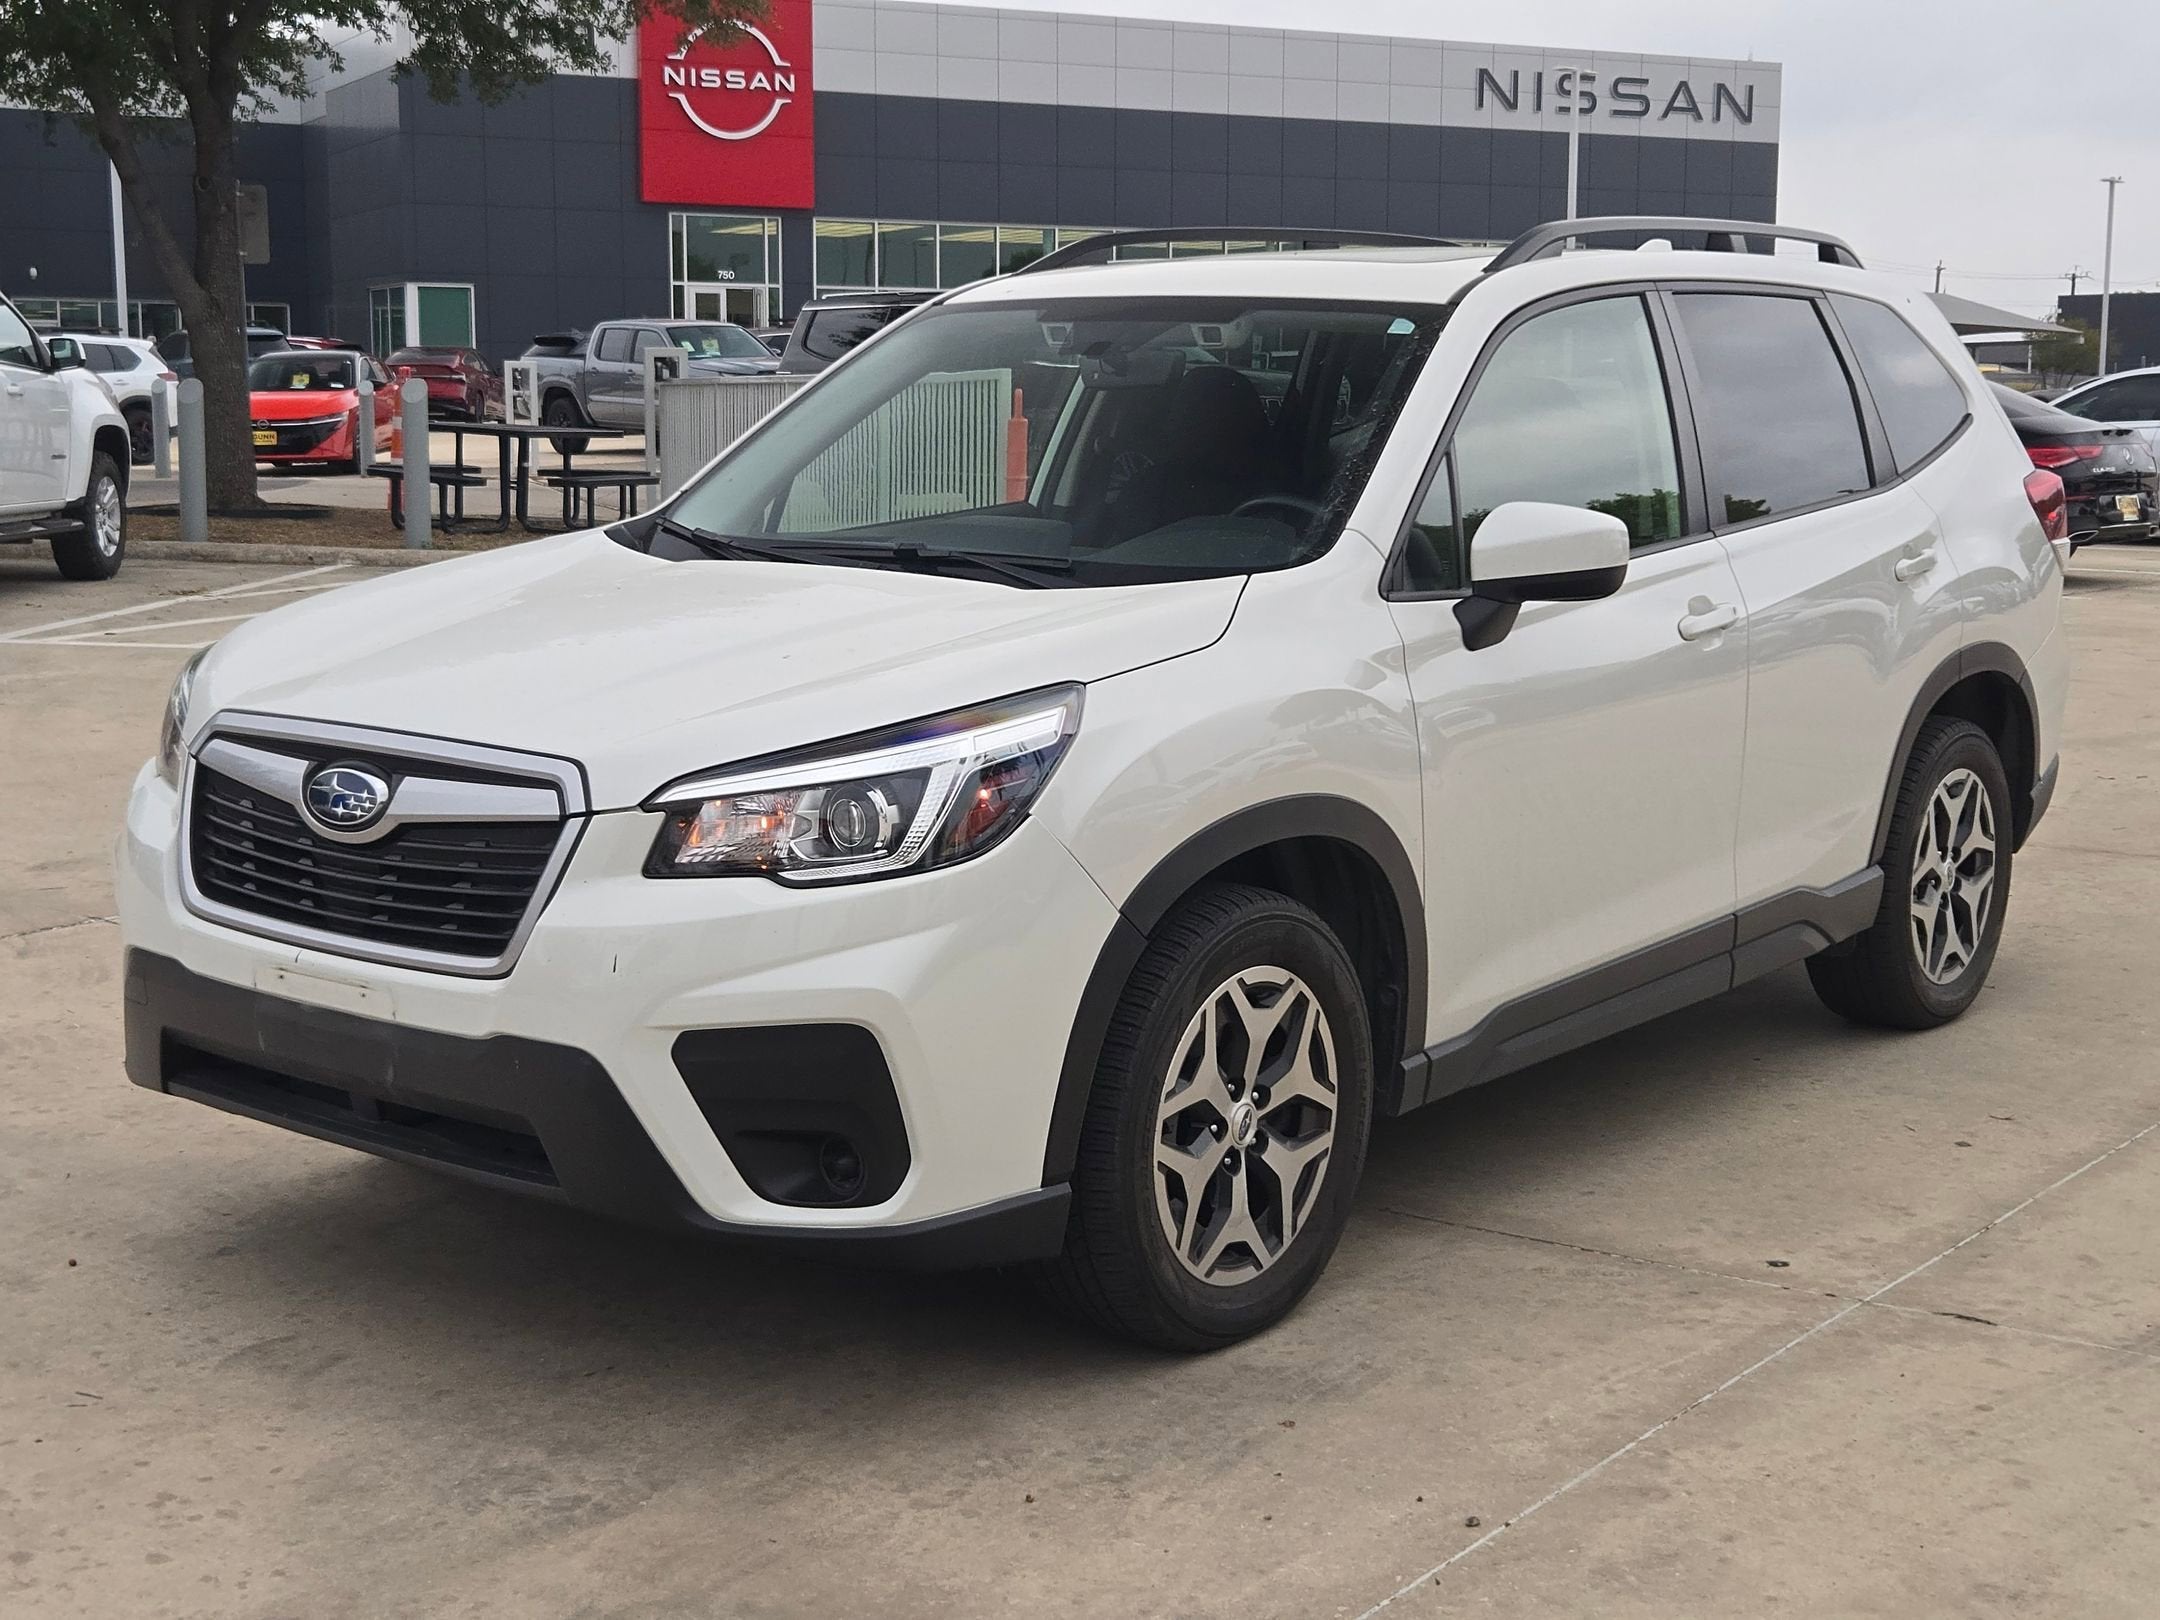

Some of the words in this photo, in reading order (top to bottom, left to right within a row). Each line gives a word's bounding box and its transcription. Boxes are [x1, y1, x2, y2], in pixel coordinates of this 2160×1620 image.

[664, 66, 795, 93] NISSAN
[1475, 67, 1754, 125] NISSAN
[717, 270, 735, 280] 750
